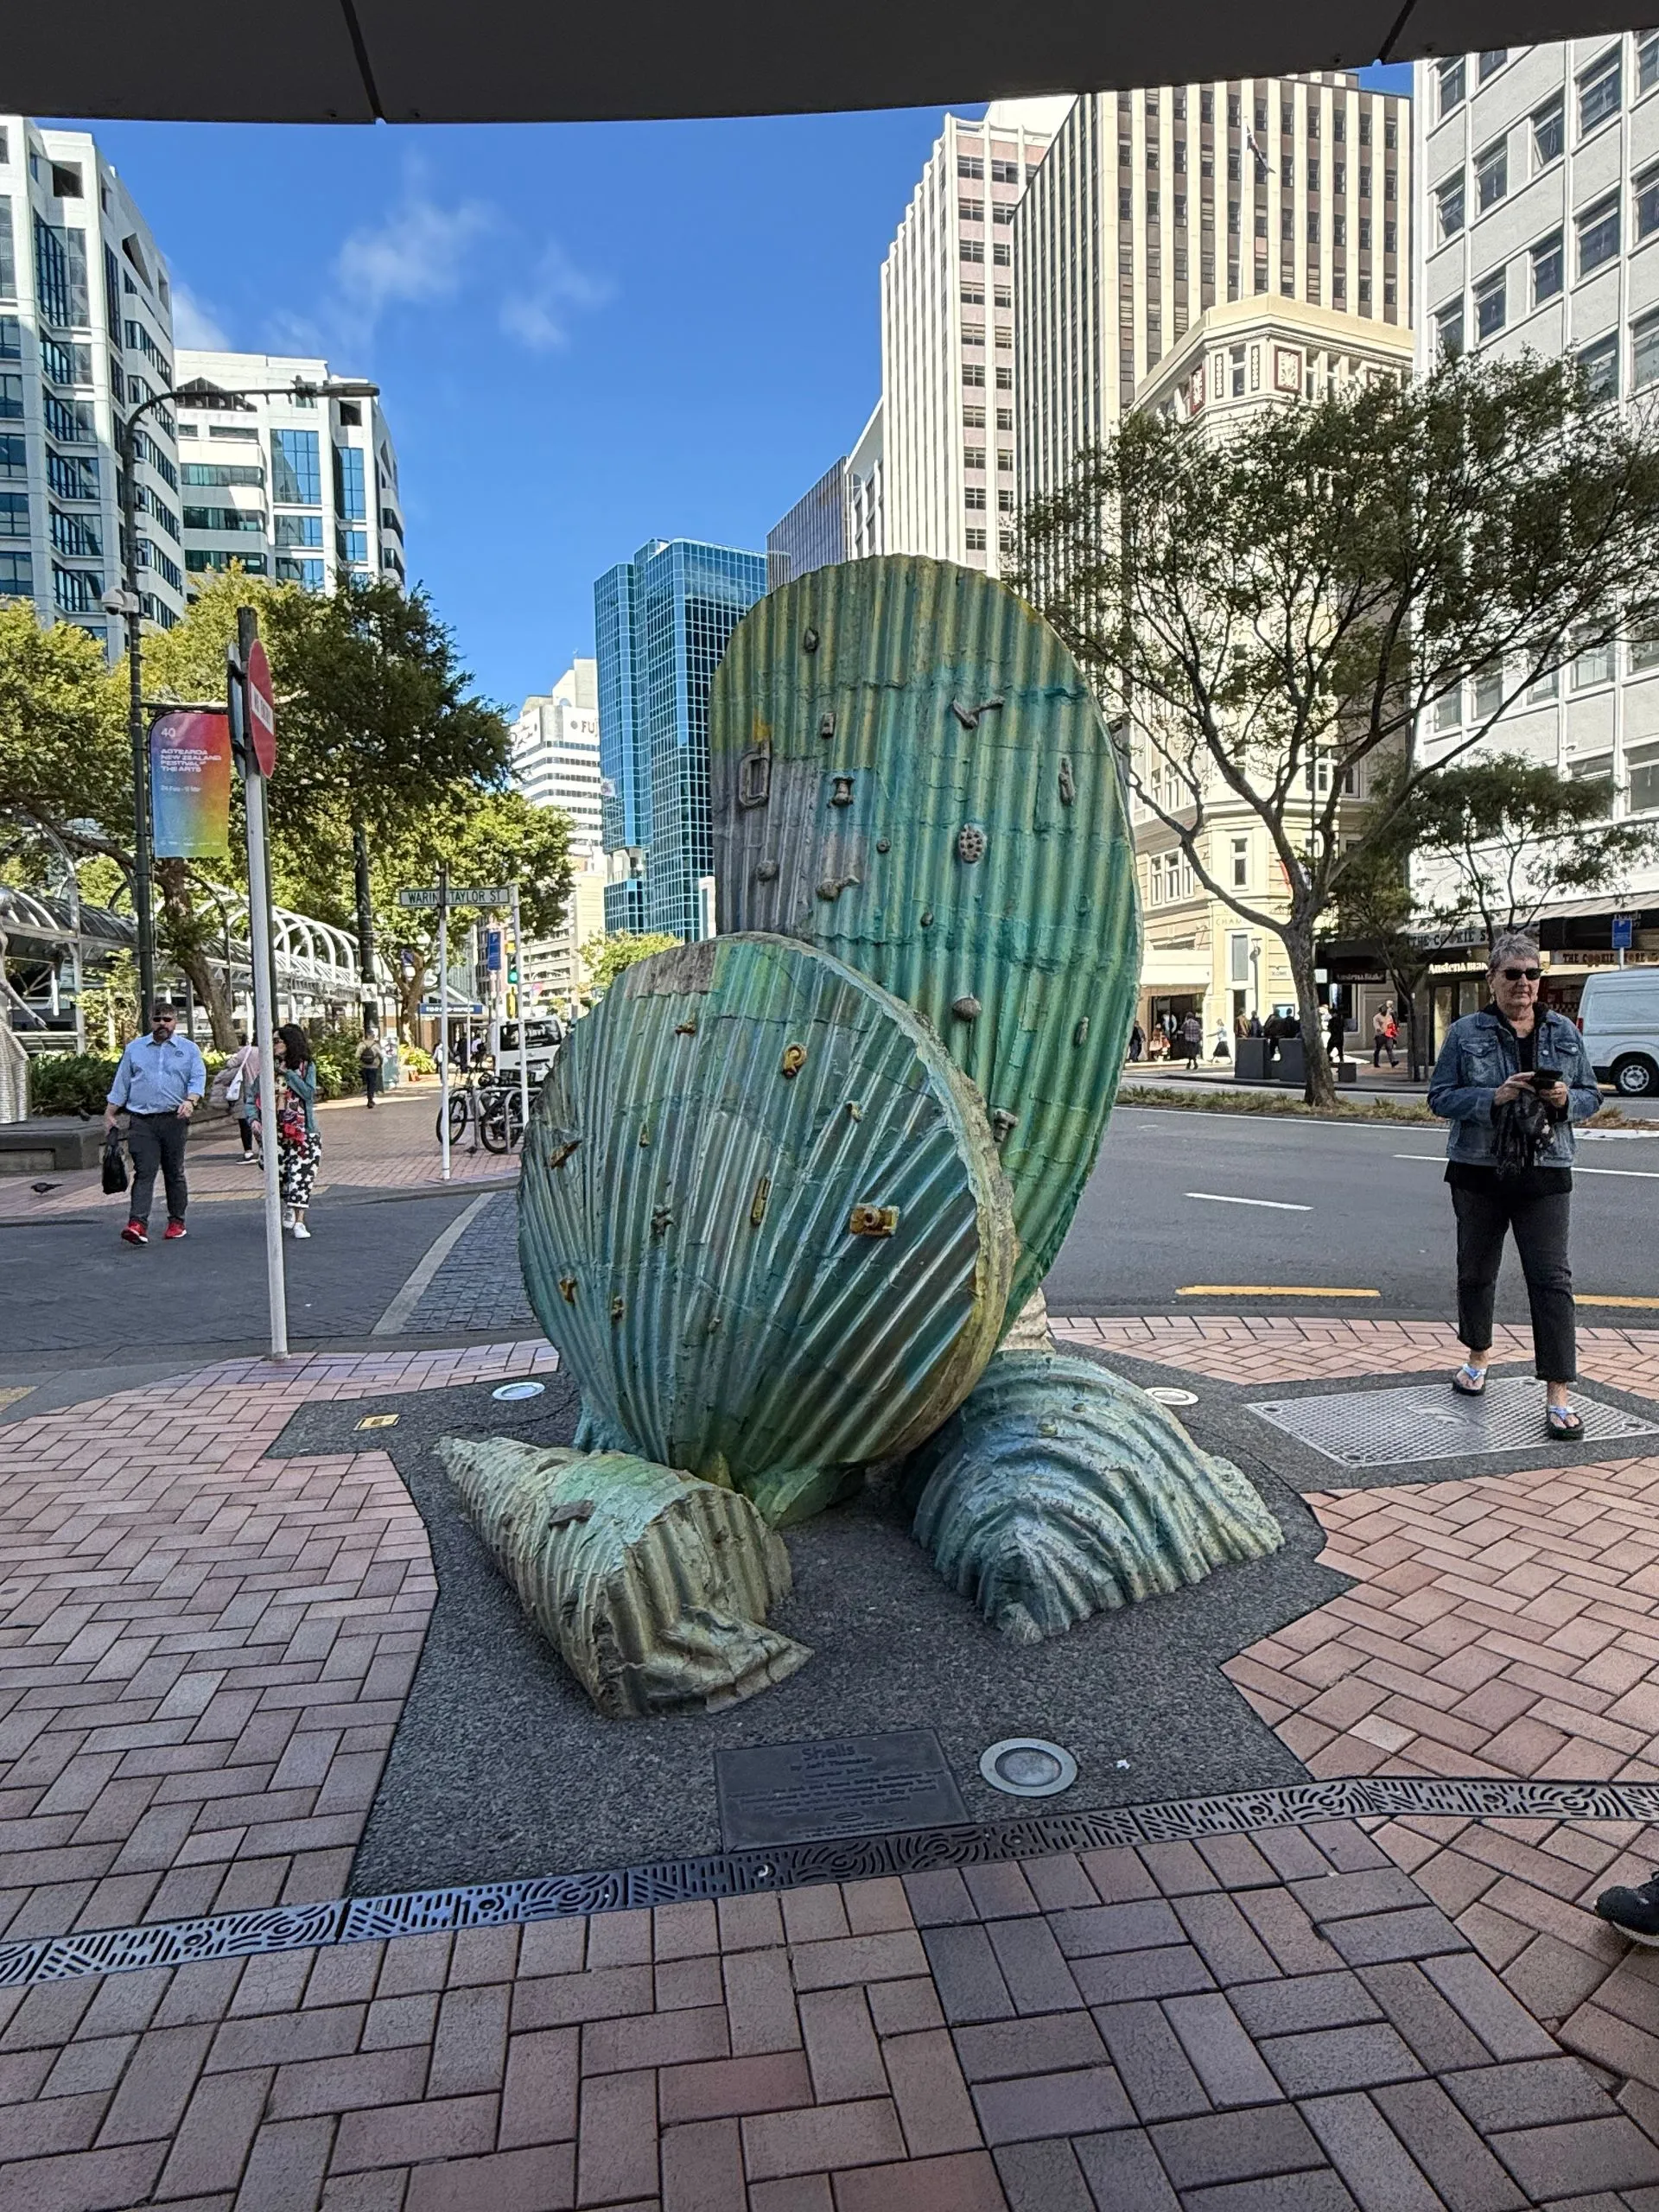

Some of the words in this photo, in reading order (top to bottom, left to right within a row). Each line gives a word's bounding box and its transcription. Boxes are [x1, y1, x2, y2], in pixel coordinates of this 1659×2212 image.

[161, 728, 176, 738] 40
[408, 891, 440, 904] WARIN
[449, 890, 485, 902] TAYLOR
[490, 890, 501, 902] ST
[1410, 935, 1430, 947] THE
[1562, 953, 1580, 963] THE
[1583, 953, 1615, 963] COOKIE
[802, 1743, 855, 1761] Shells
